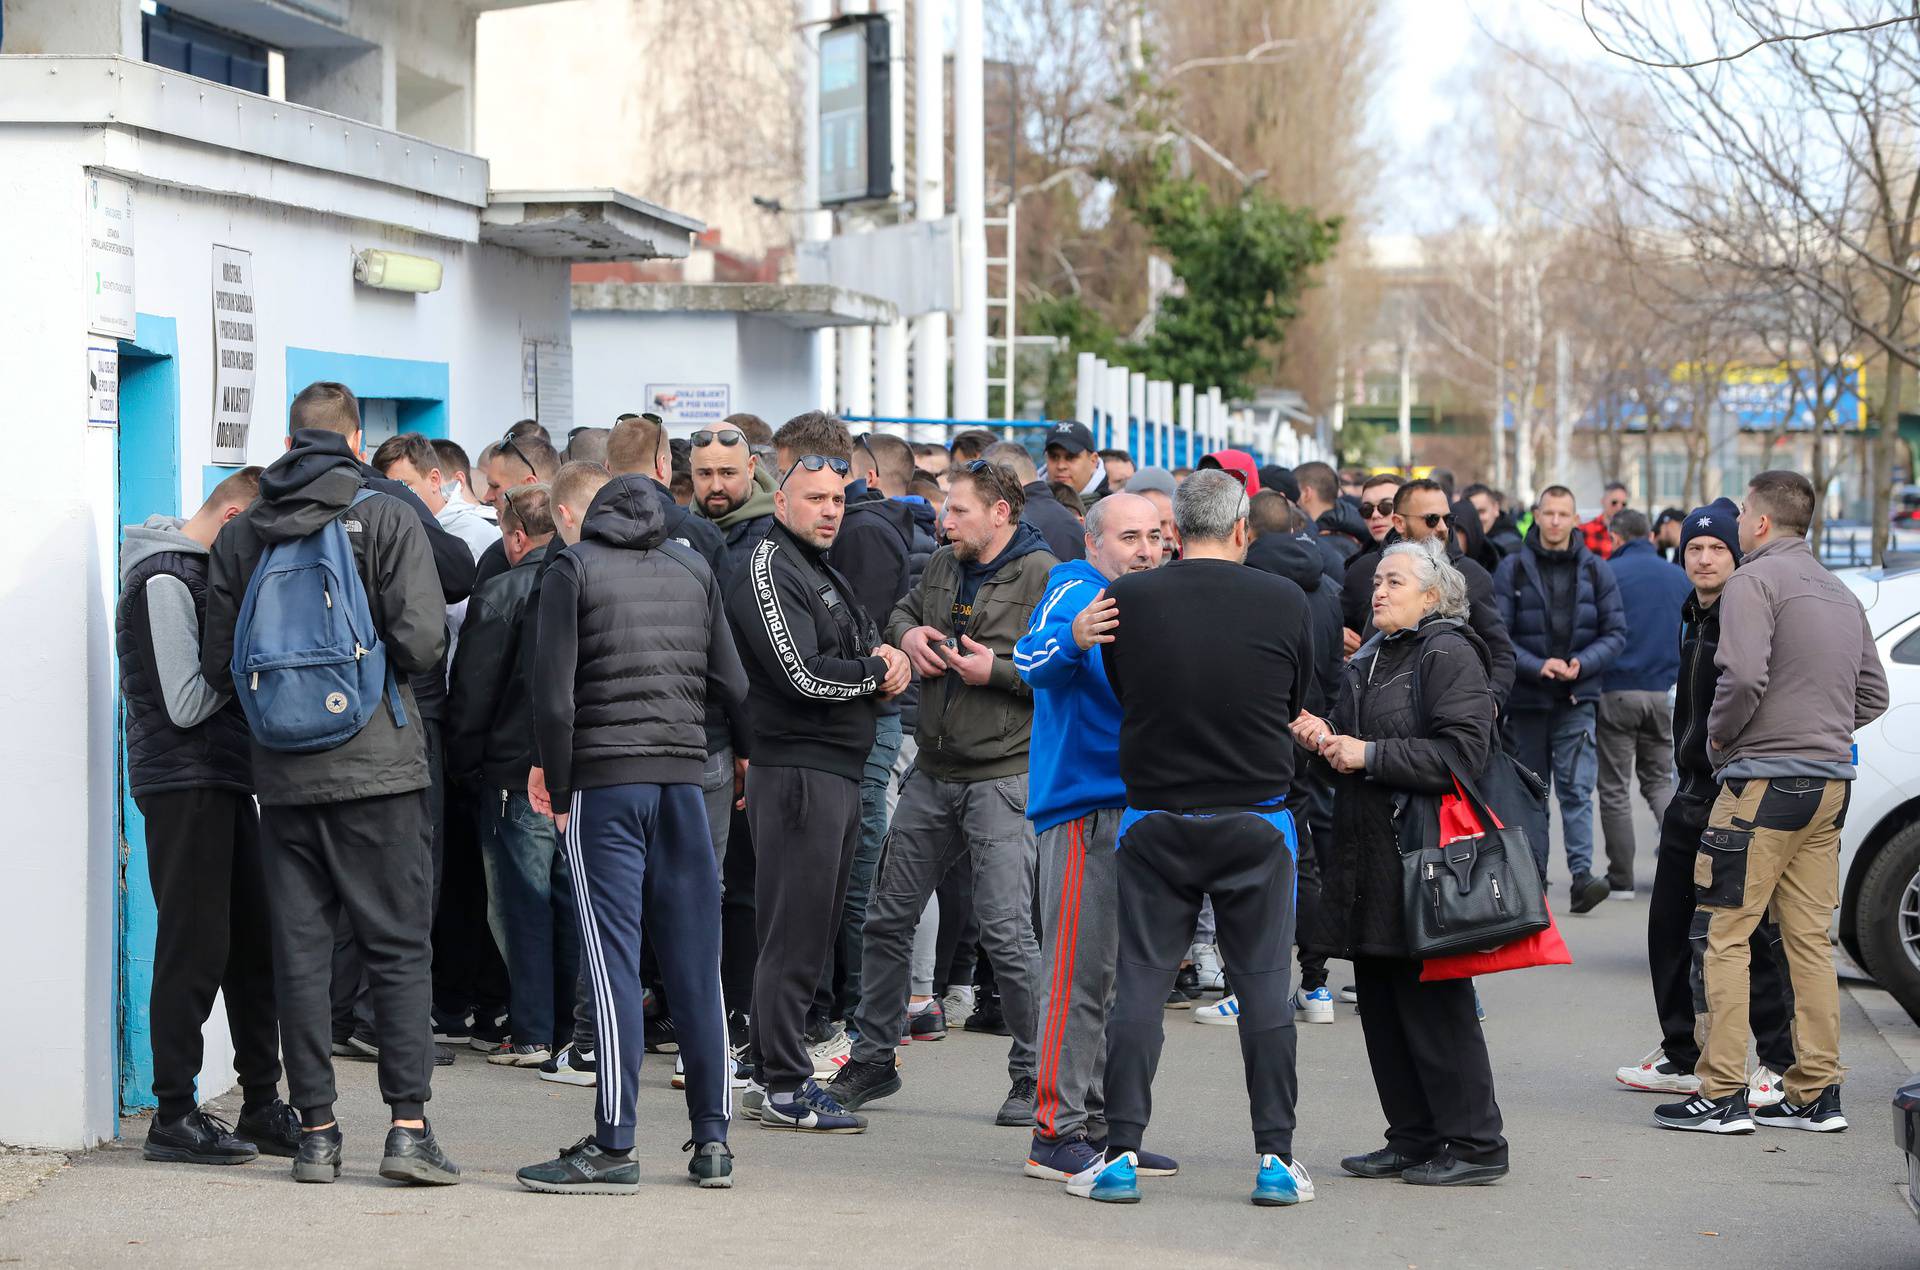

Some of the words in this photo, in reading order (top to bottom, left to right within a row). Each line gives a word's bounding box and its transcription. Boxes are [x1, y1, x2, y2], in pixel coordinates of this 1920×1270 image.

[223, 386, 230, 412] NA
[754, 553, 770, 591] PITBULL
[763, 597, 791, 654] PITBULL
[788, 659, 830, 697] PITBULL
